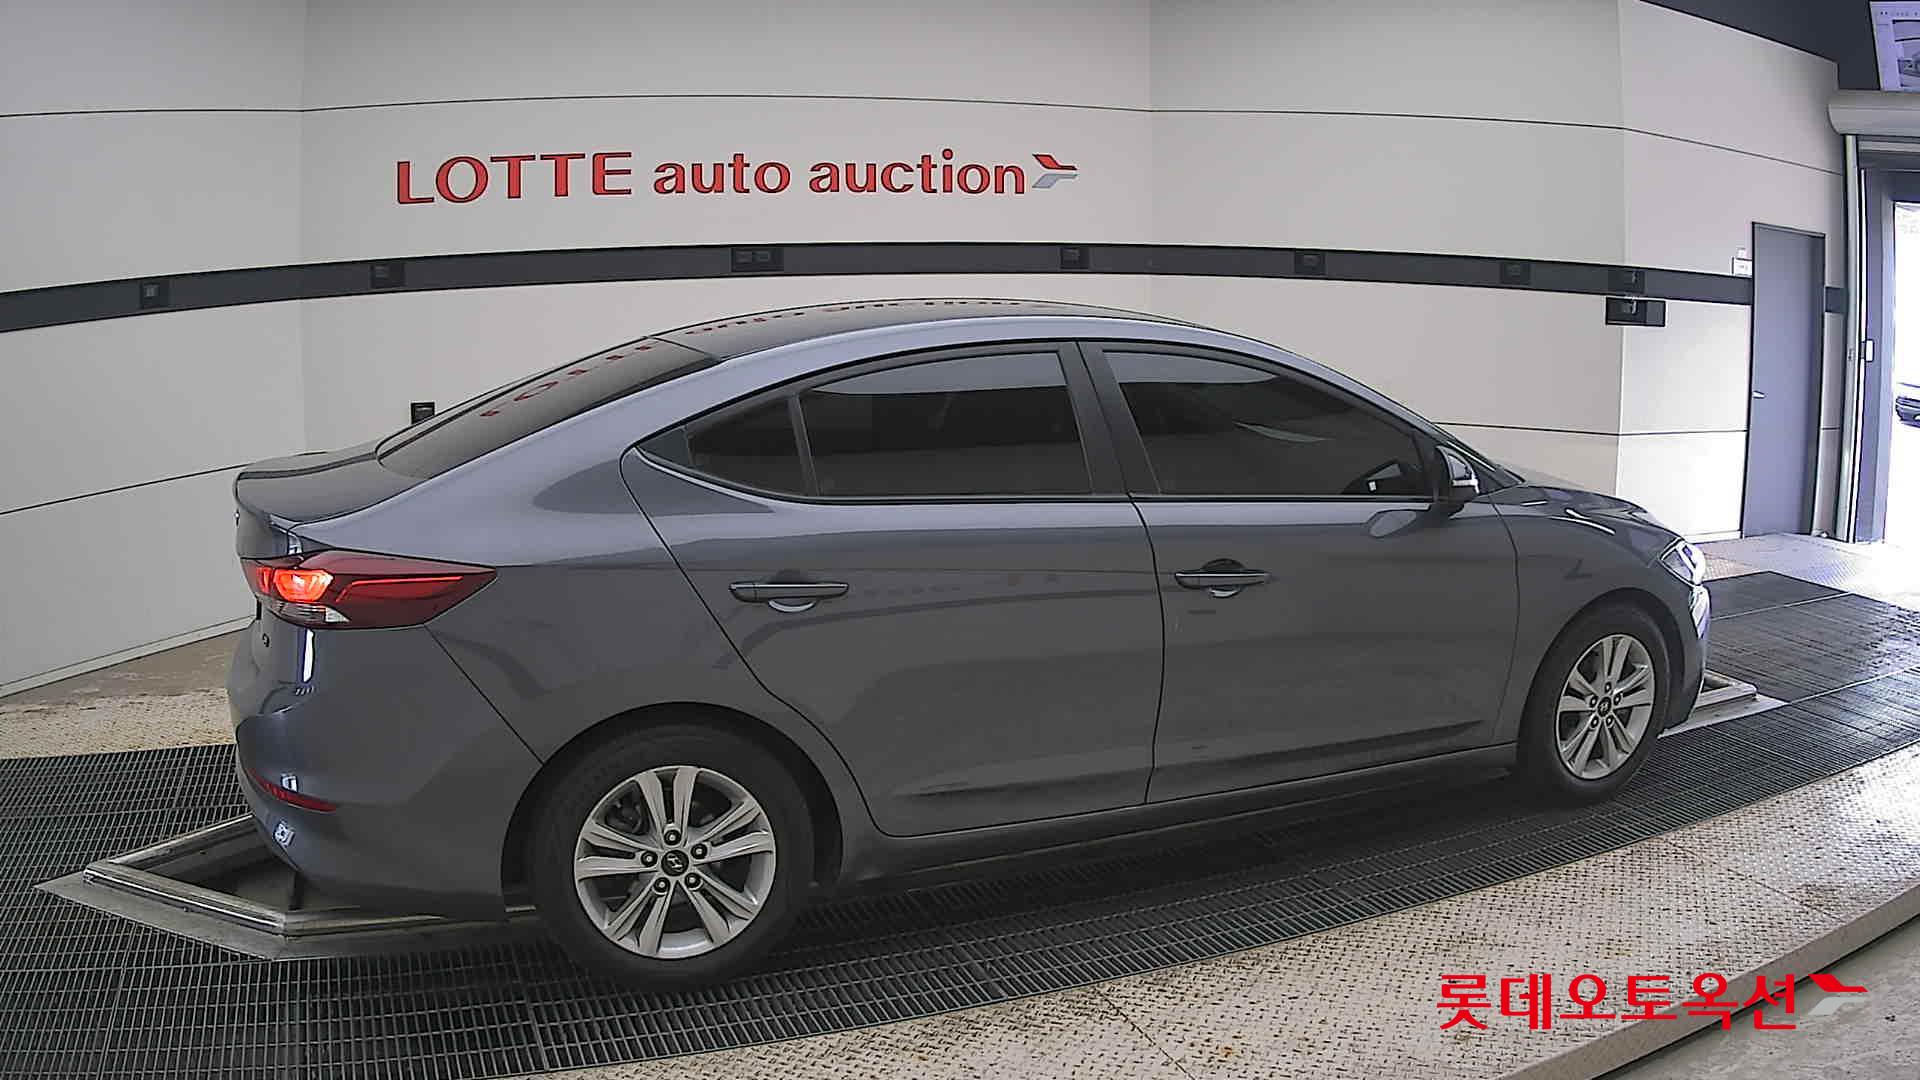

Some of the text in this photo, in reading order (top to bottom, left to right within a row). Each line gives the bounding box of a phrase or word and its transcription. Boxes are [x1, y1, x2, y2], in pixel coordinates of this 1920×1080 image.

[397, 148, 1025, 204] LOTTE auto auction
